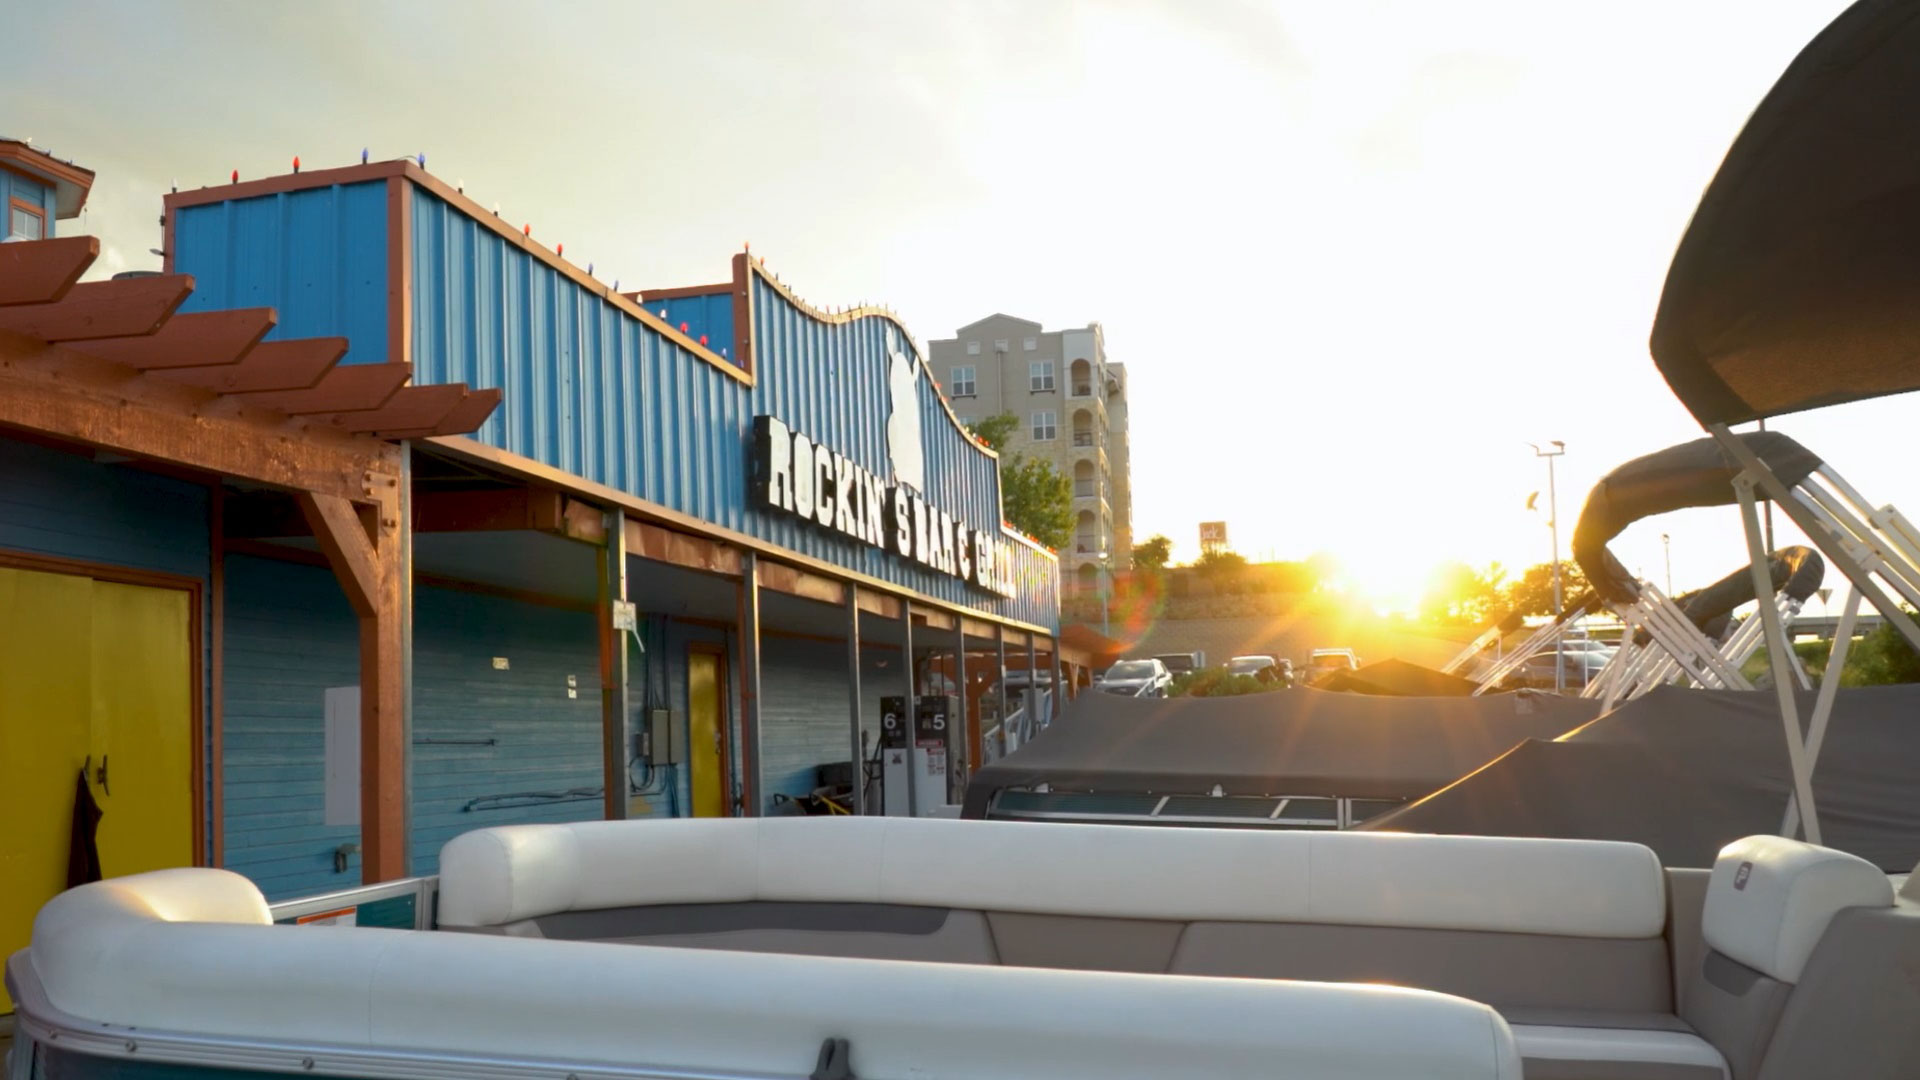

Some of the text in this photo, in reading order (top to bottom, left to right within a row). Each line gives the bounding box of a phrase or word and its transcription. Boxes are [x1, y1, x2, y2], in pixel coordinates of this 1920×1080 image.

[913, 494, 957, 577] BAR
[884, 713, 896, 729] 6
[933, 714, 945, 730] 5
